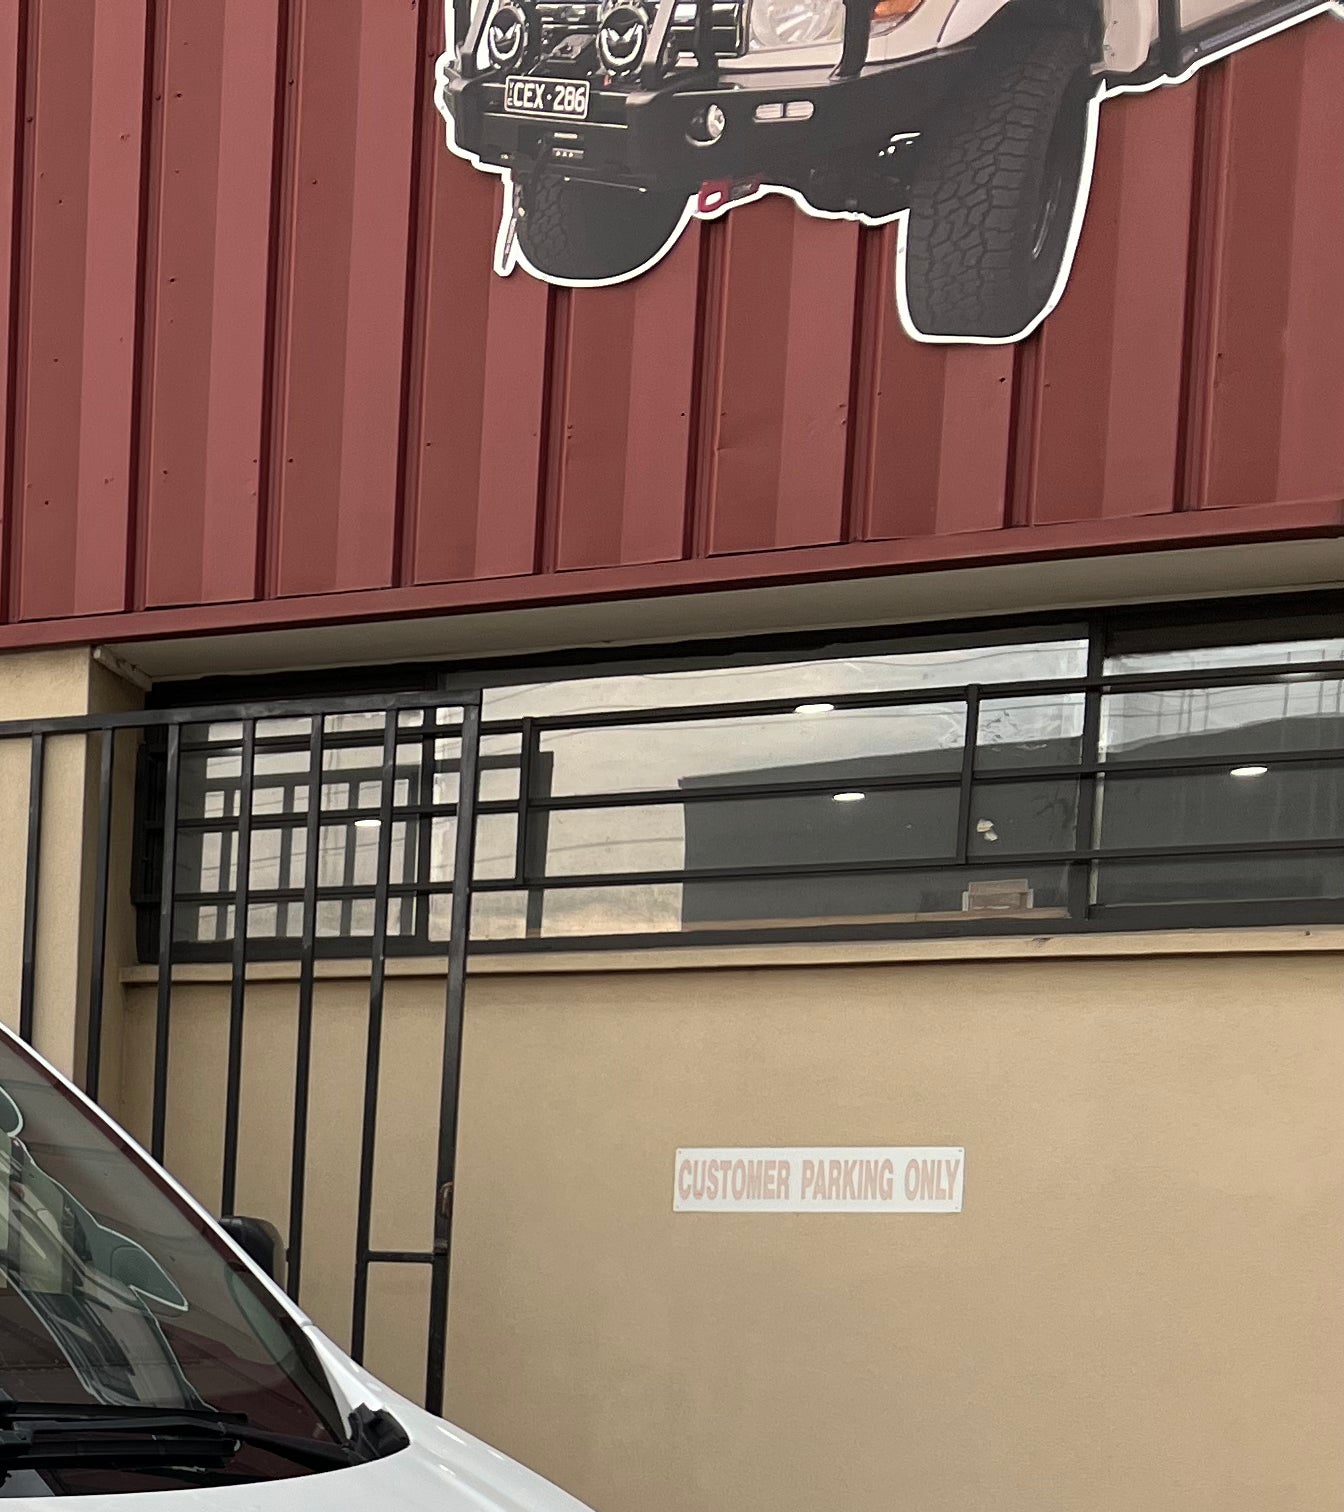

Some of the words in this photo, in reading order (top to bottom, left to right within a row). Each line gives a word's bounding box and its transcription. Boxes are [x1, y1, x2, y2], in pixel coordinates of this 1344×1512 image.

[678, 1158, 791, 1201] CUSTOMER
[801, 1158, 894, 1201] PARKING
[904, 1158, 961, 1201] ONLY
